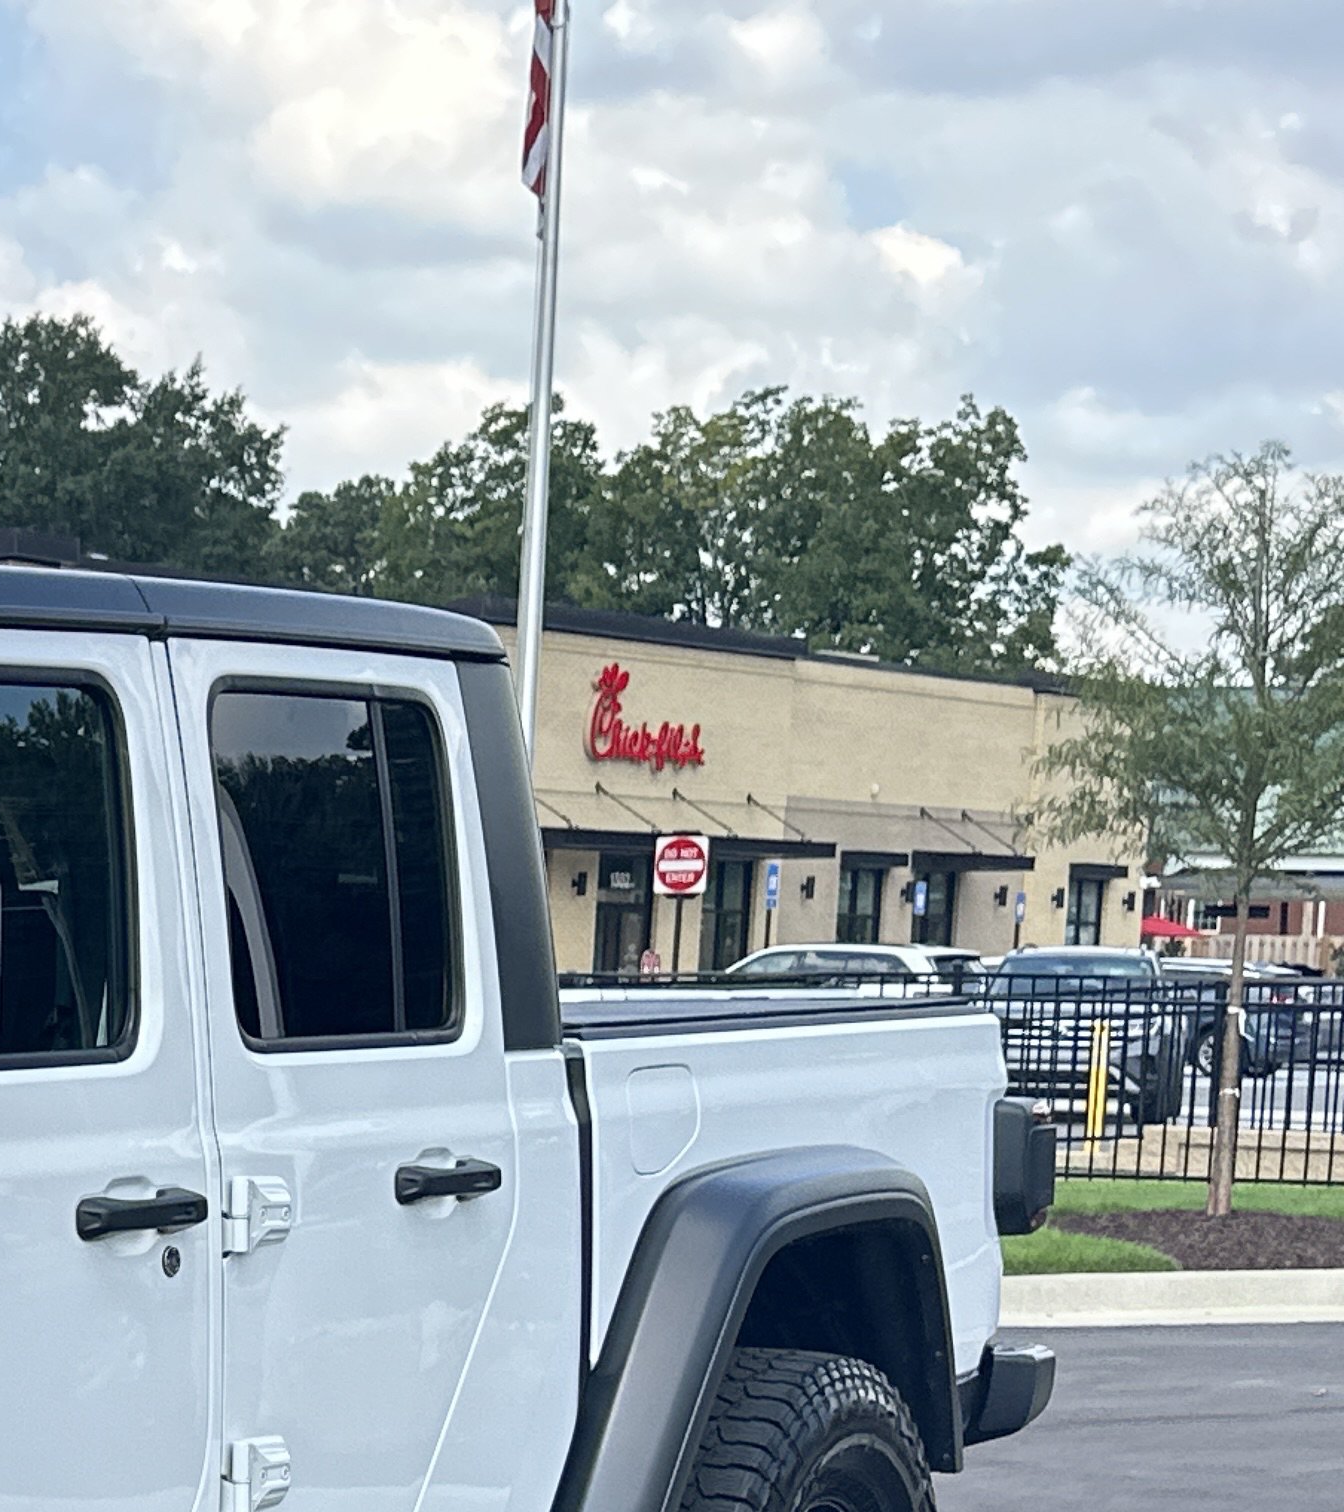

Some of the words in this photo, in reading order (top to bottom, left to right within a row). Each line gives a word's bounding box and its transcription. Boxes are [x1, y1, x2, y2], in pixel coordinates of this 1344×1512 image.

[664, 847, 677, 858] DO
[680, 847, 698, 858] NOT
[665, 872, 695, 883] ENTER
